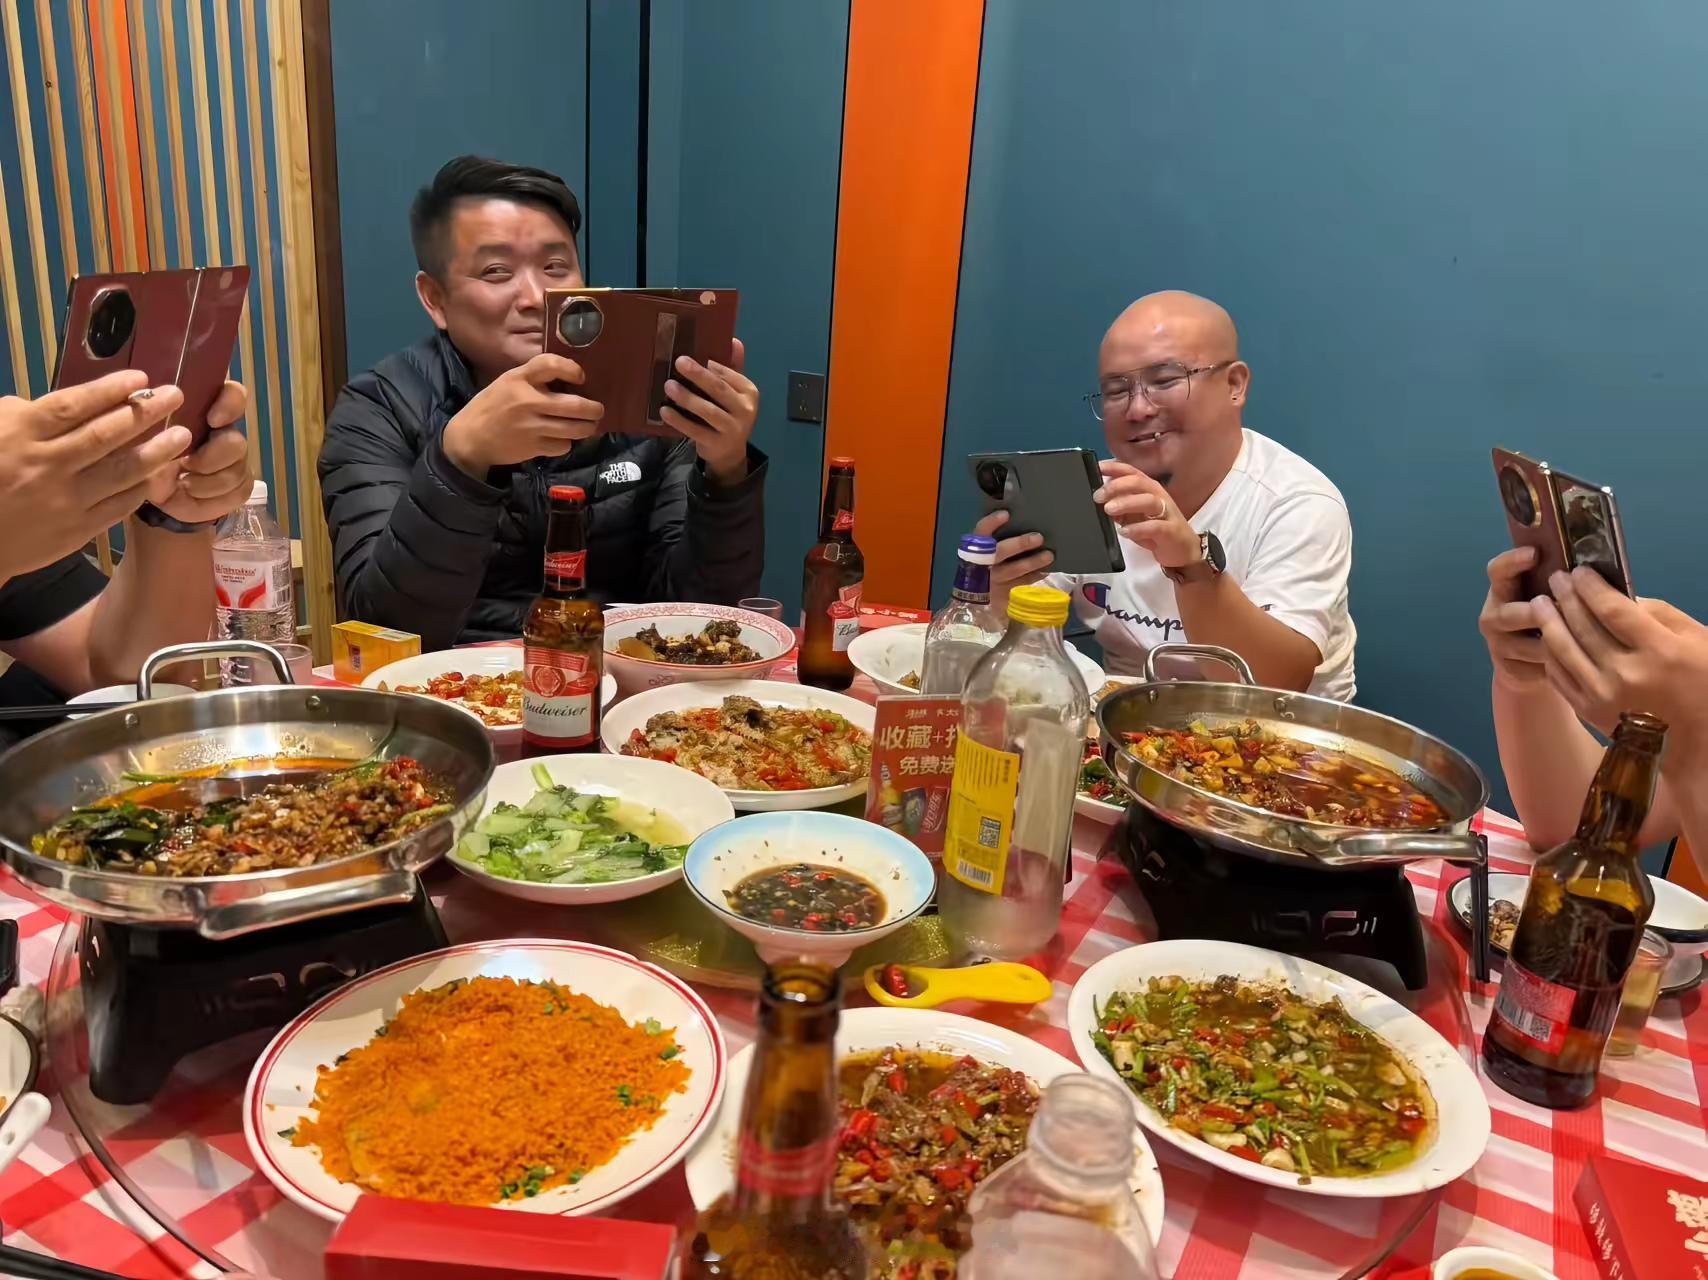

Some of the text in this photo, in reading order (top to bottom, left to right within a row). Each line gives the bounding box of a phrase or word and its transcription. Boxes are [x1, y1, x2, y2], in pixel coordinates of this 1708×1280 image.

[600, 465, 627, 480] NORTH
[609, 462, 625, 472] THE
[606, 473, 628, 484] FACE
[525, 696, 587, 717] Budweiser
